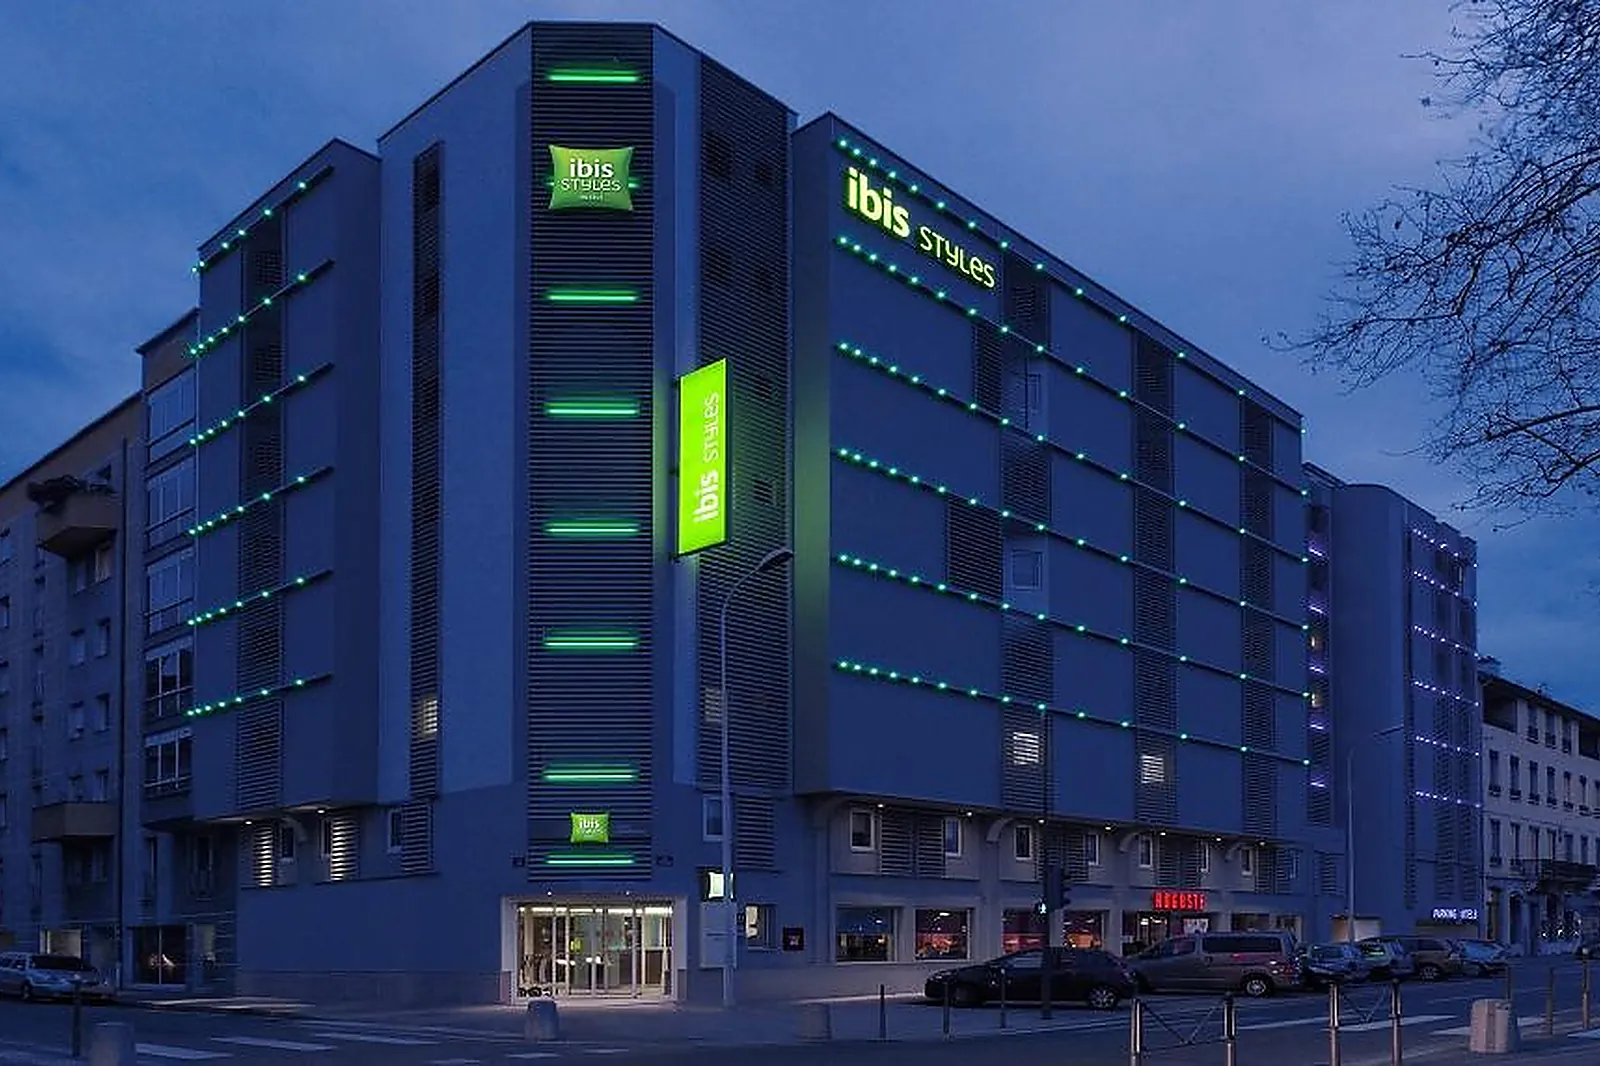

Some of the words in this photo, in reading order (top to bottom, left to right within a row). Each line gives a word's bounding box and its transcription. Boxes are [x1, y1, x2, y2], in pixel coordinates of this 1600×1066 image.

[570, 158, 614, 178] ibis
[848, 166, 910, 238] ibis
[692, 469, 719, 523] ibis
